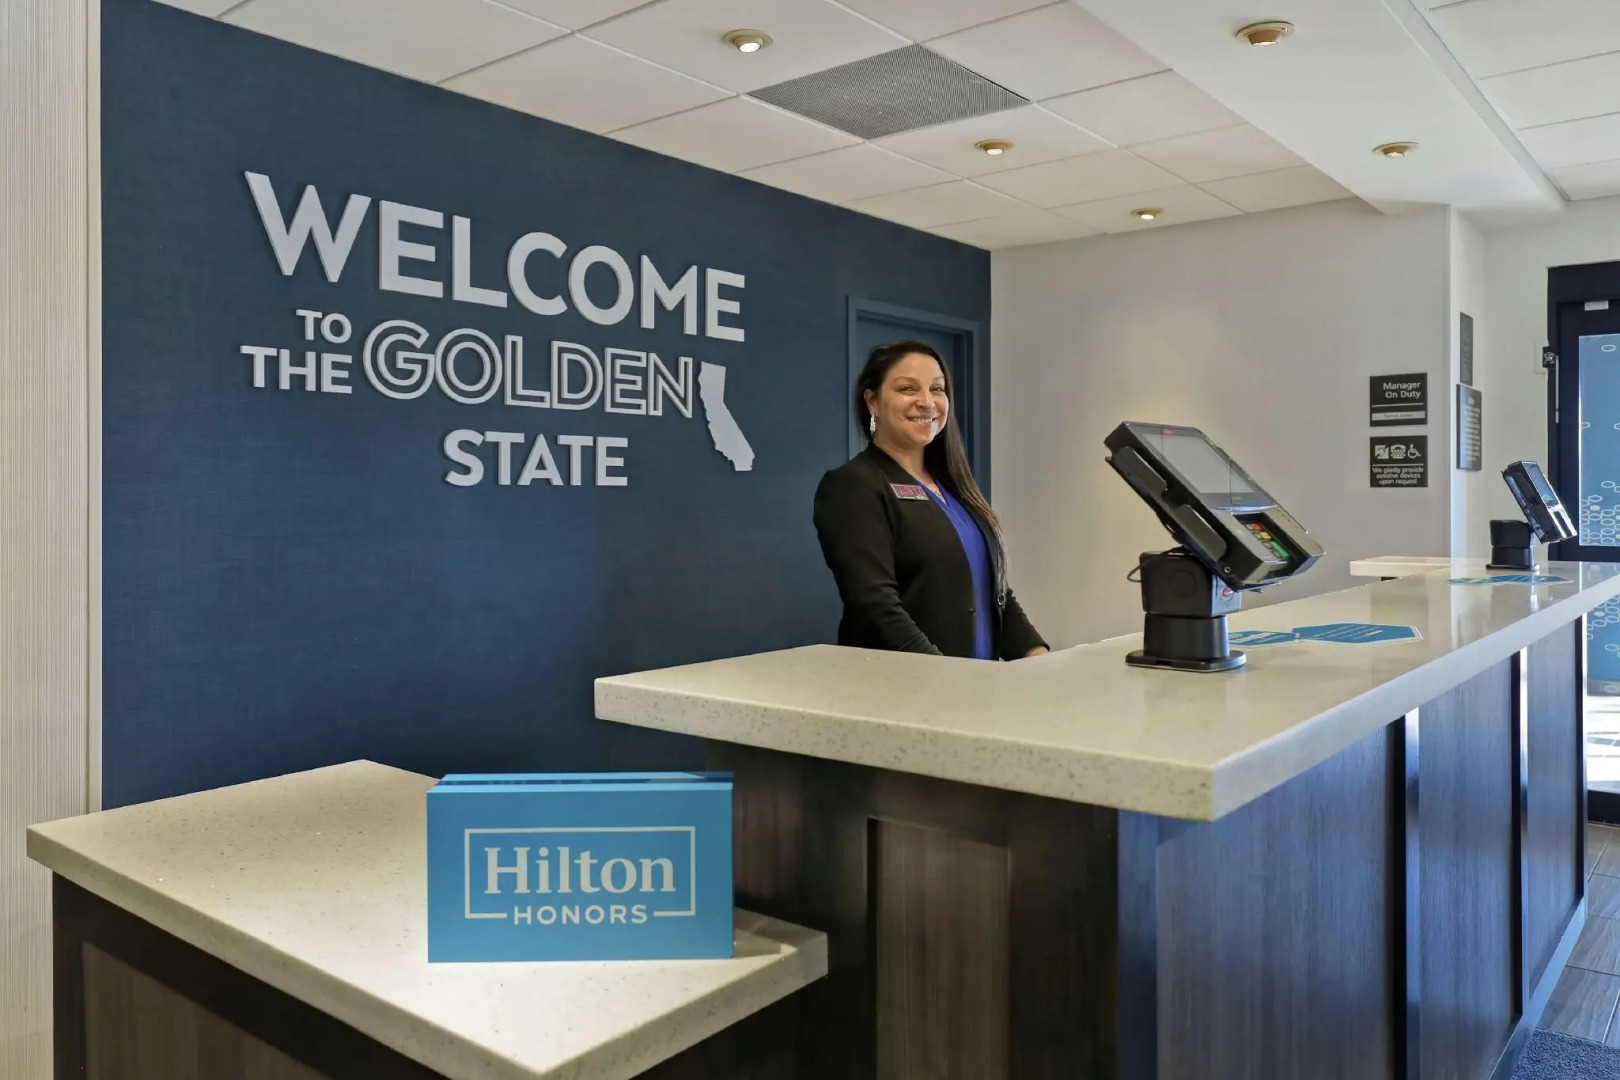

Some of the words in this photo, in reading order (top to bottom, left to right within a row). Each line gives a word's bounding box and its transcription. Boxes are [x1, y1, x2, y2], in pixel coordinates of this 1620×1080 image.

[244, 170, 746, 342] WELCOME
[296, 309, 352, 343] TO
[240, 345, 353, 394] THE
[363, 320, 694, 418] GOLDEN
[1383, 382, 1421, 391] Manager
[1385, 391, 1398, 399] On
[1400, 390, 1421, 399] Duty
[443, 429, 629, 487] STATE
[1383, 466, 1401, 474] gladly
[1402, 466, 1424, 474] provide
[484, 846, 676, 894] Hilton
[513, 904, 648, 925] HONORS
